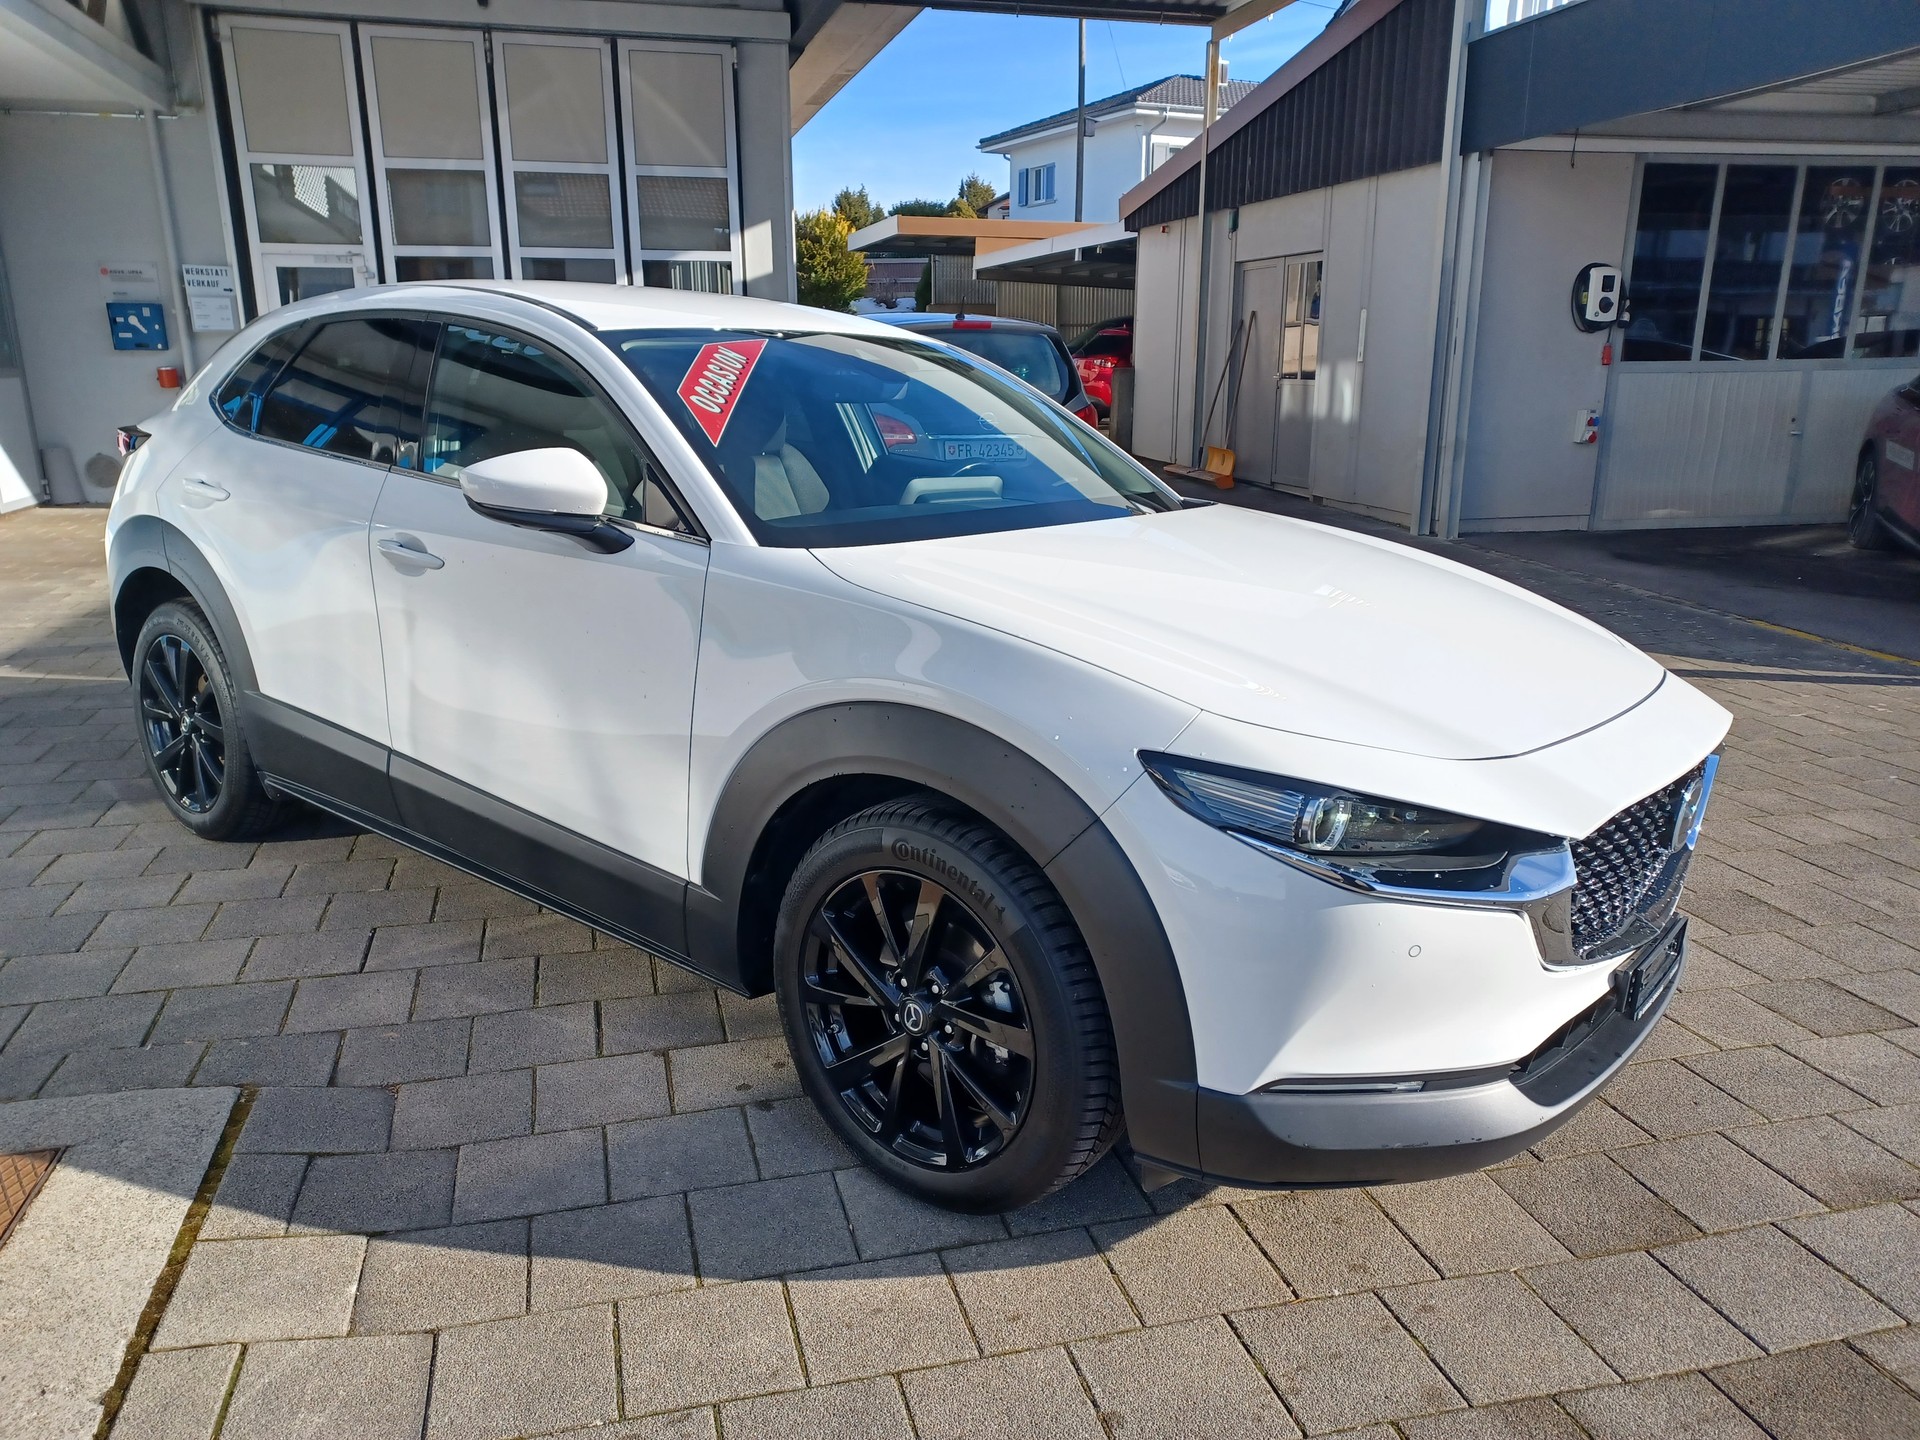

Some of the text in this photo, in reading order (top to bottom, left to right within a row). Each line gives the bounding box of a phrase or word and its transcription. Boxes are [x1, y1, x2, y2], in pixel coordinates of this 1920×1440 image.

[185, 268, 228, 277] WERKSTATT
[187, 279, 220, 288] VERKAUF
[689, 345, 749, 414] OCCASION
[957, 443, 1015, 458] FR 42345
[891, 837, 995, 911] Continental
